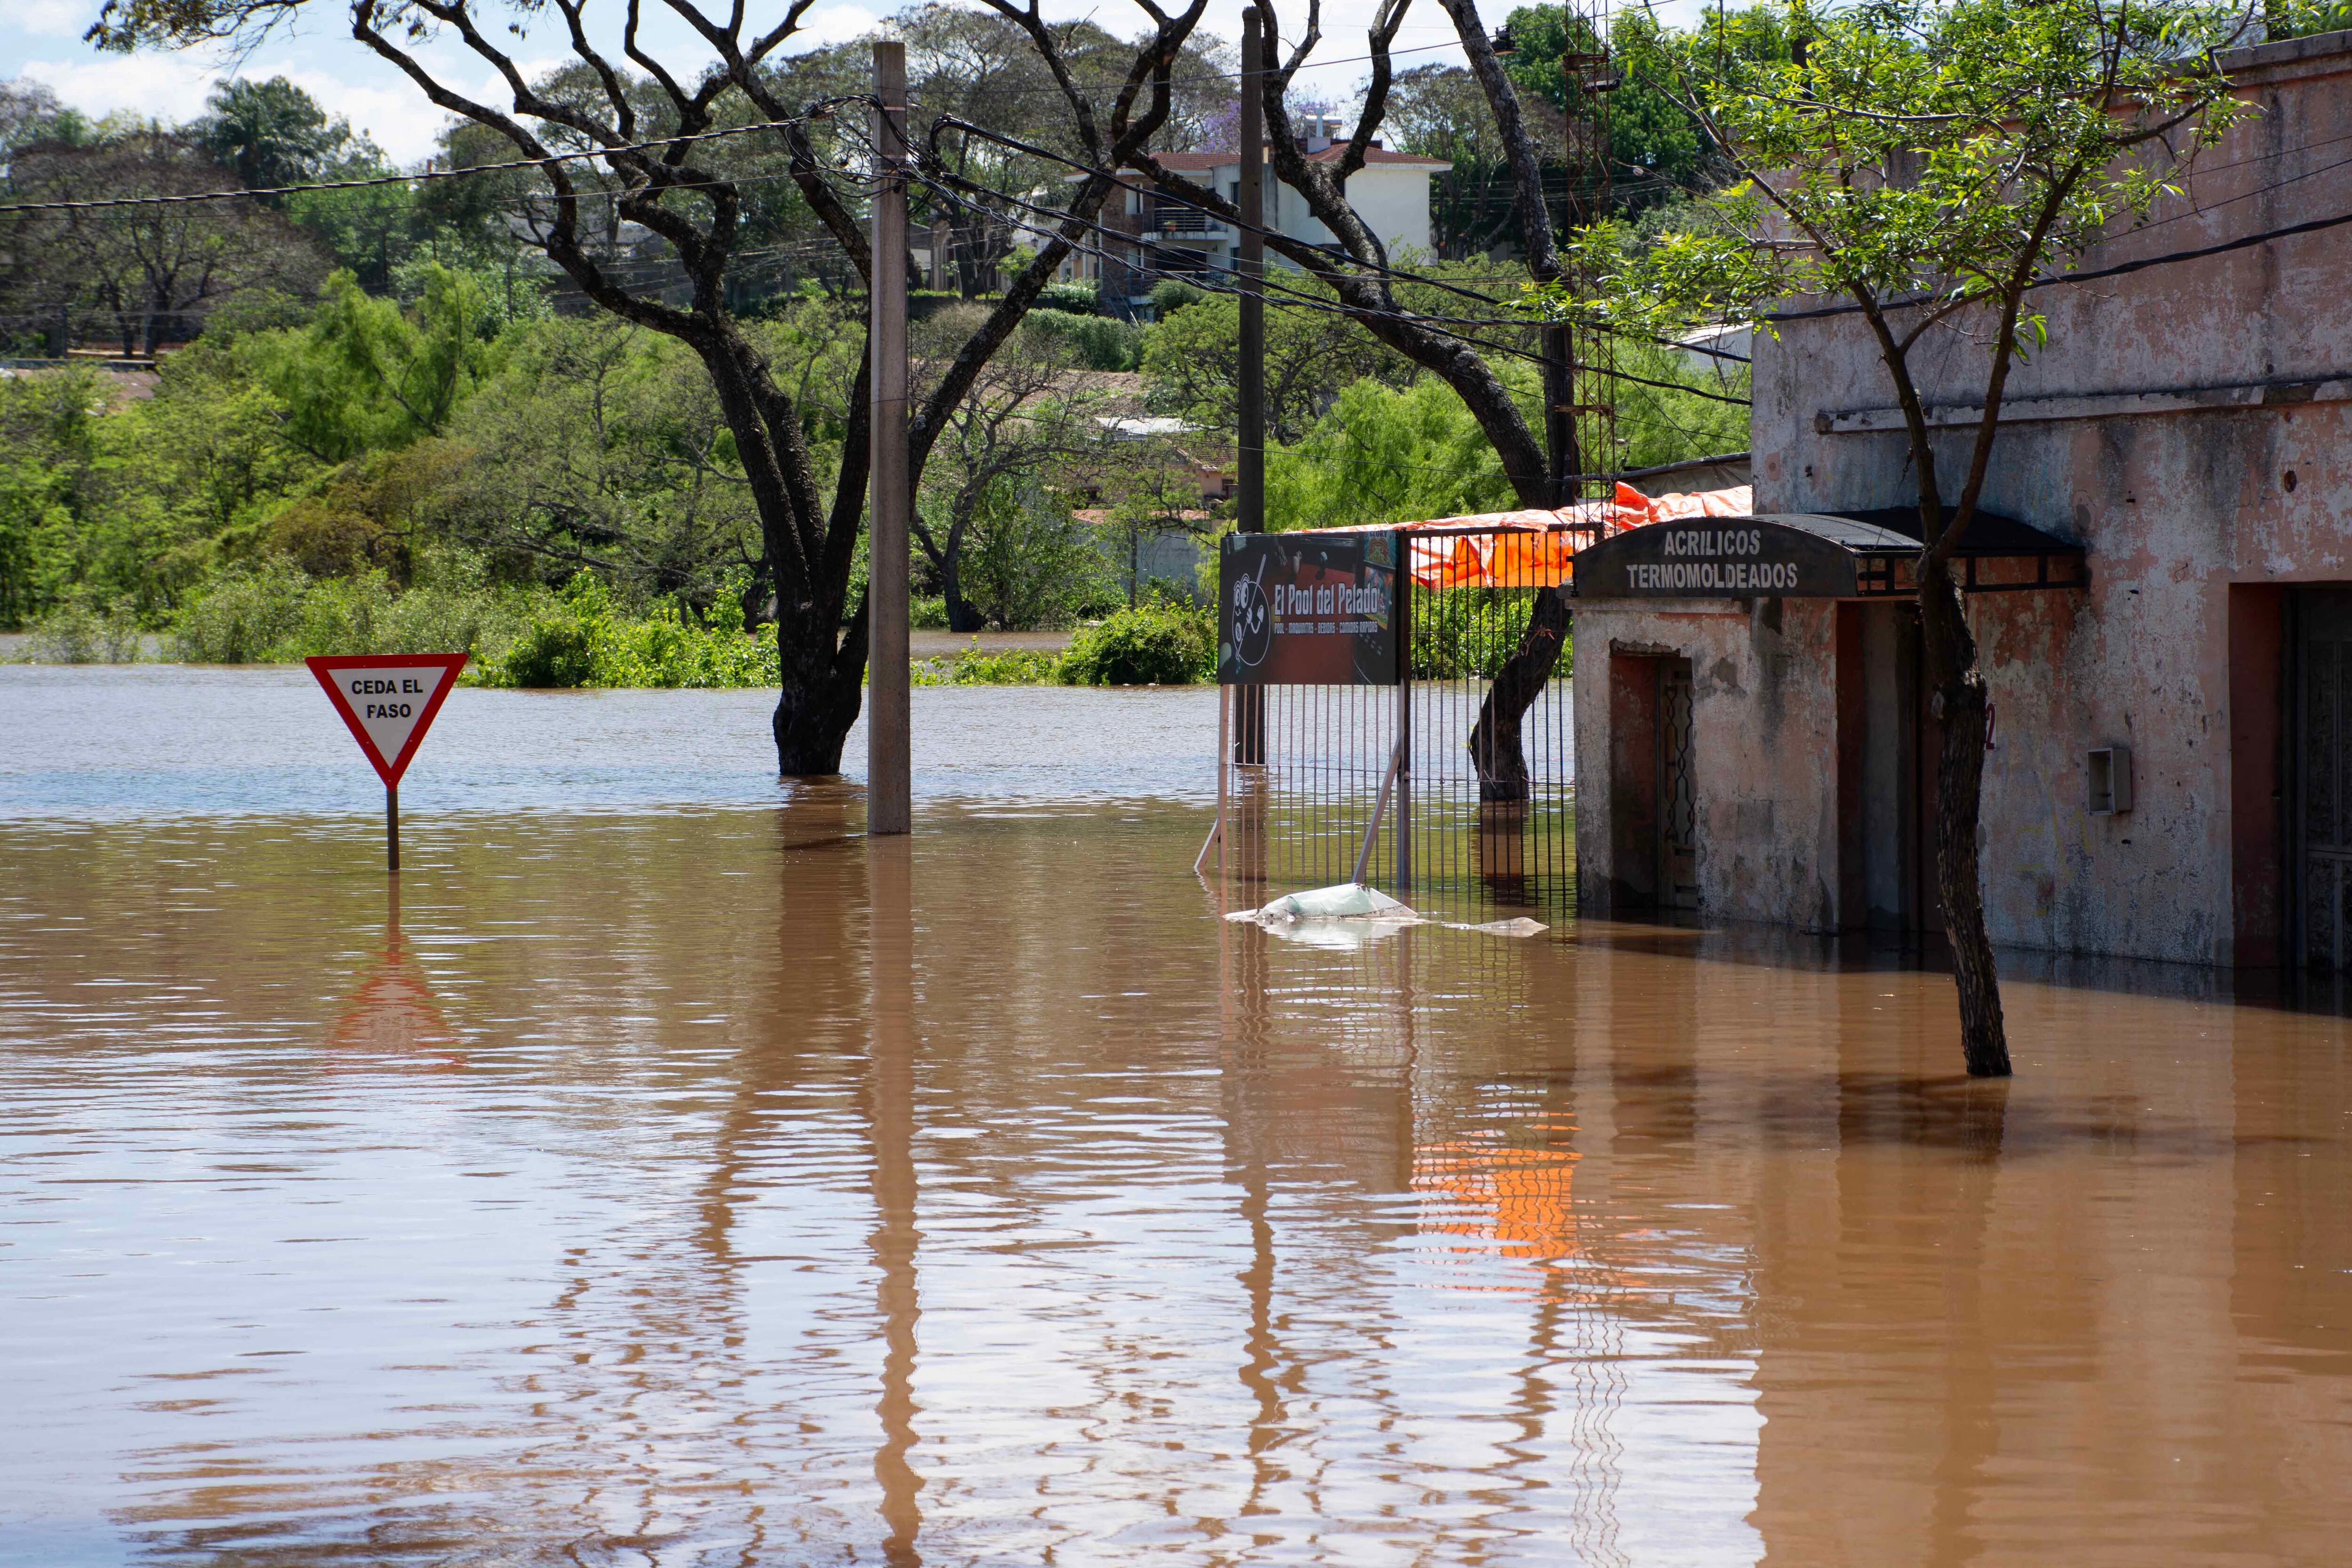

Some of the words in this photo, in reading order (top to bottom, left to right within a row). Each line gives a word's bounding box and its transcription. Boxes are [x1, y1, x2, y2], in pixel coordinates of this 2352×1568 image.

[1664, 529, 1761, 556] ACRILICOS
[1626, 563, 1798, 589] TERMOMOLDEADOS
[1274, 584, 1284, 615] El
[1288, 584, 1313, 615] Pool
[1317, 583, 1334, 615] del
[1338, 582, 1378, 614] Pelado
[351, 679, 397, 694] CEDA
[403, 679, 423, 693] EL
